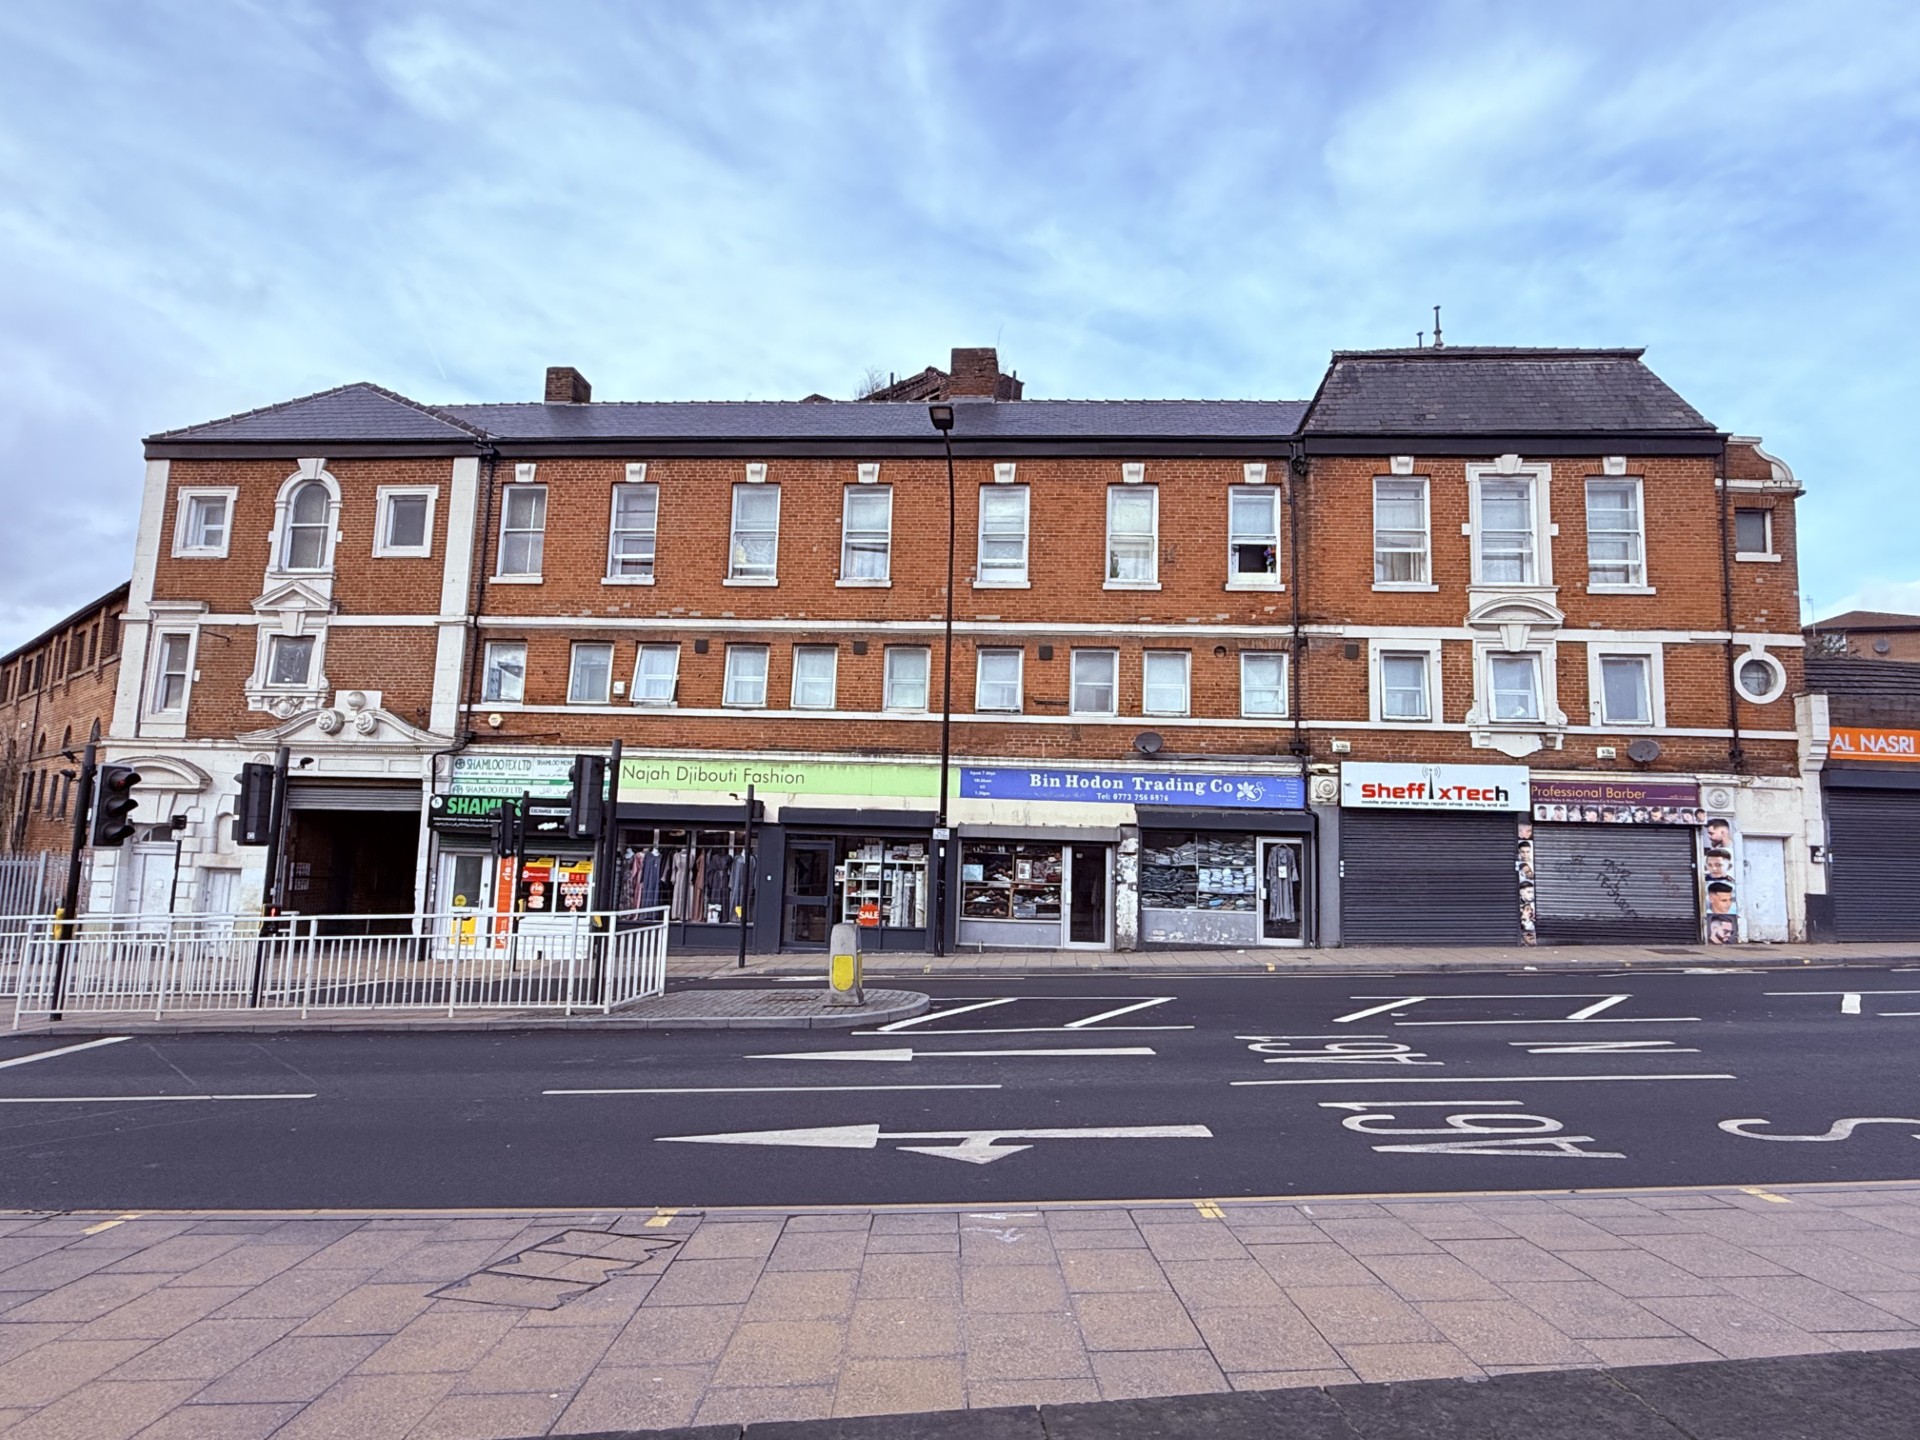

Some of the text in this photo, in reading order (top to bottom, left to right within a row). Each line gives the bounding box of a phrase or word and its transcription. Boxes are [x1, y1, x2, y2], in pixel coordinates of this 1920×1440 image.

[1832, 733, 1914, 754] AL NASRI
[518, 760, 532, 772] LTD
[622, 764, 805, 785] Najah Djibouti Fashion
[1030, 773, 1233, 796] Bin Hodon Trading Co
[1530, 786, 1647, 799] Professional Barber
[859, 910, 879, 919] SALE
[1318, 1100, 1627, 1159] A61
